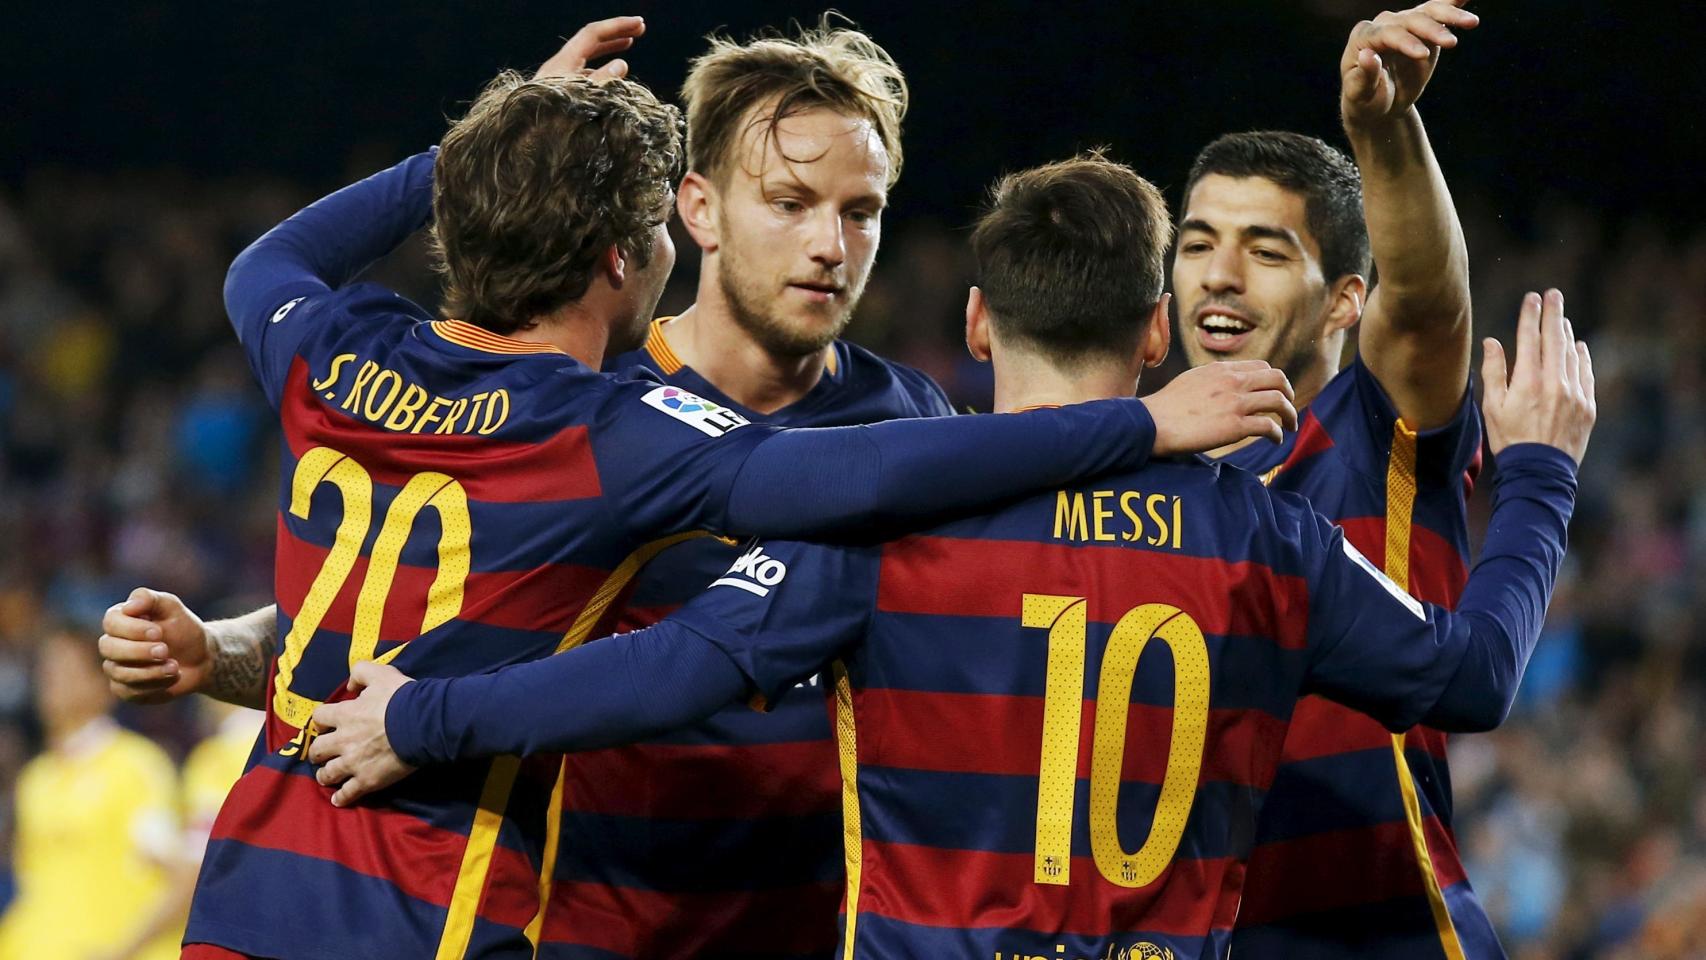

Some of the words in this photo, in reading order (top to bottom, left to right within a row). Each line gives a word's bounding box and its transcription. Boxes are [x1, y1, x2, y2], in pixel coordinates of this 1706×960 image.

[313, 353, 357, 401] S.
[341, 359, 510, 435] ROBERTO
[273, 446, 472, 729] 20
[1053, 489, 1182, 549] MESSI
[1021, 594, 1210, 888] 10
